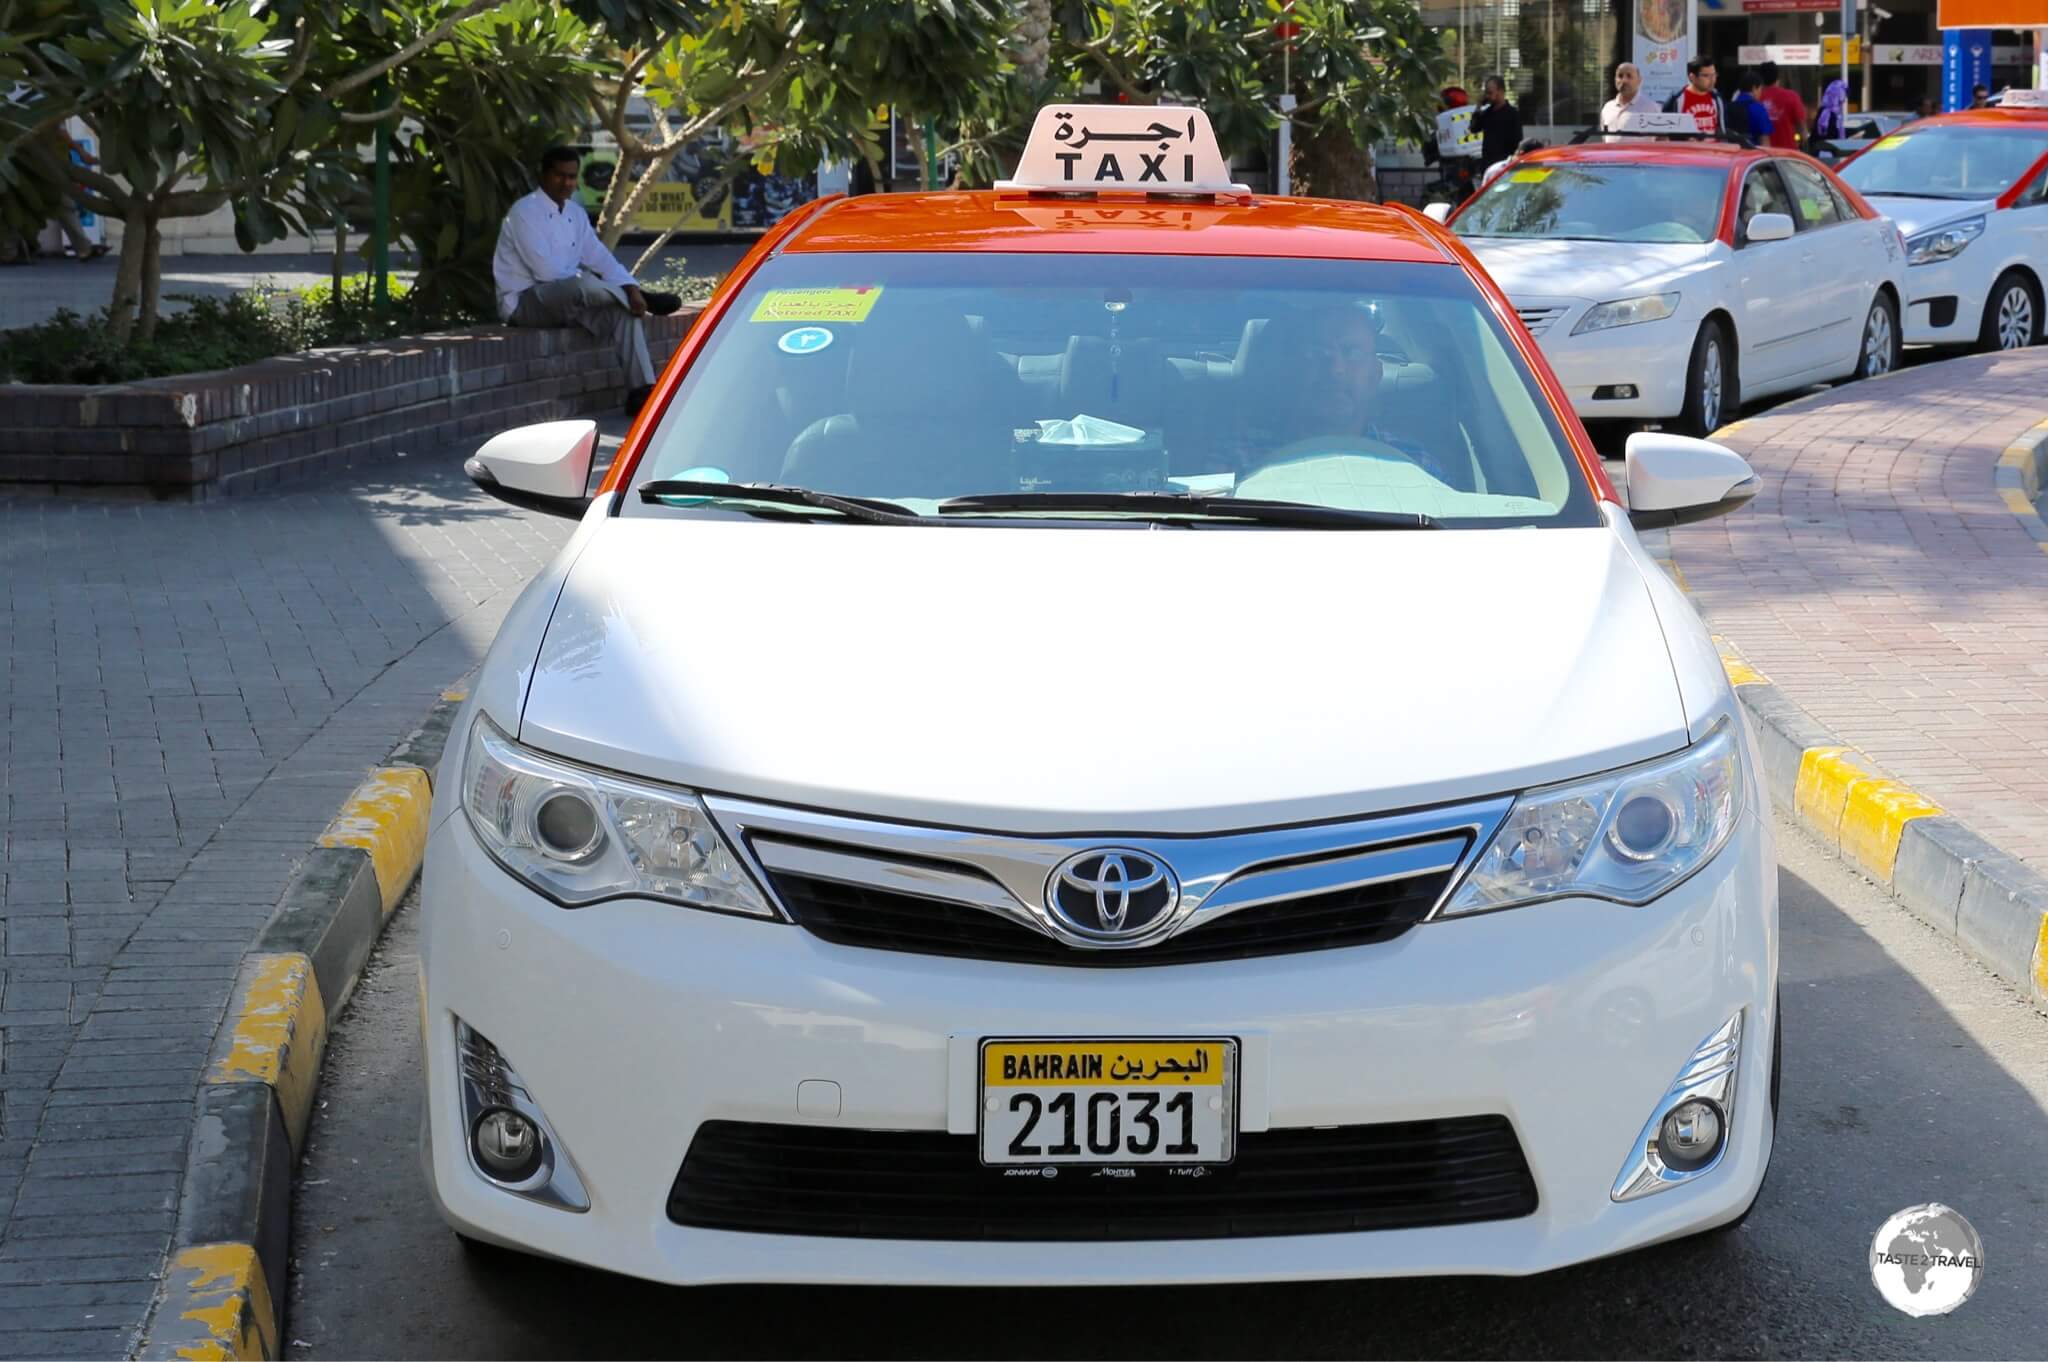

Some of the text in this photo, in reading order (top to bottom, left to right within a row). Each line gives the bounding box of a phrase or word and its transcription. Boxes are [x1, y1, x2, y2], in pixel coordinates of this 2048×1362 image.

[1055, 111, 1195, 149] اجرة
[1055, 153, 1194, 182] TAXI
[660, 192, 685, 201] WHAT
[660, 202, 683, 212] WITH
[826, 309, 858, 317] TAXI
[1003, 1054, 1102, 1079] BAHRAIN
[1110, 1048, 1208, 1081] البحرين
[1008, 1091, 1199, 1156] 21031
[1003, 1168, 1041, 1177] JONWAY
